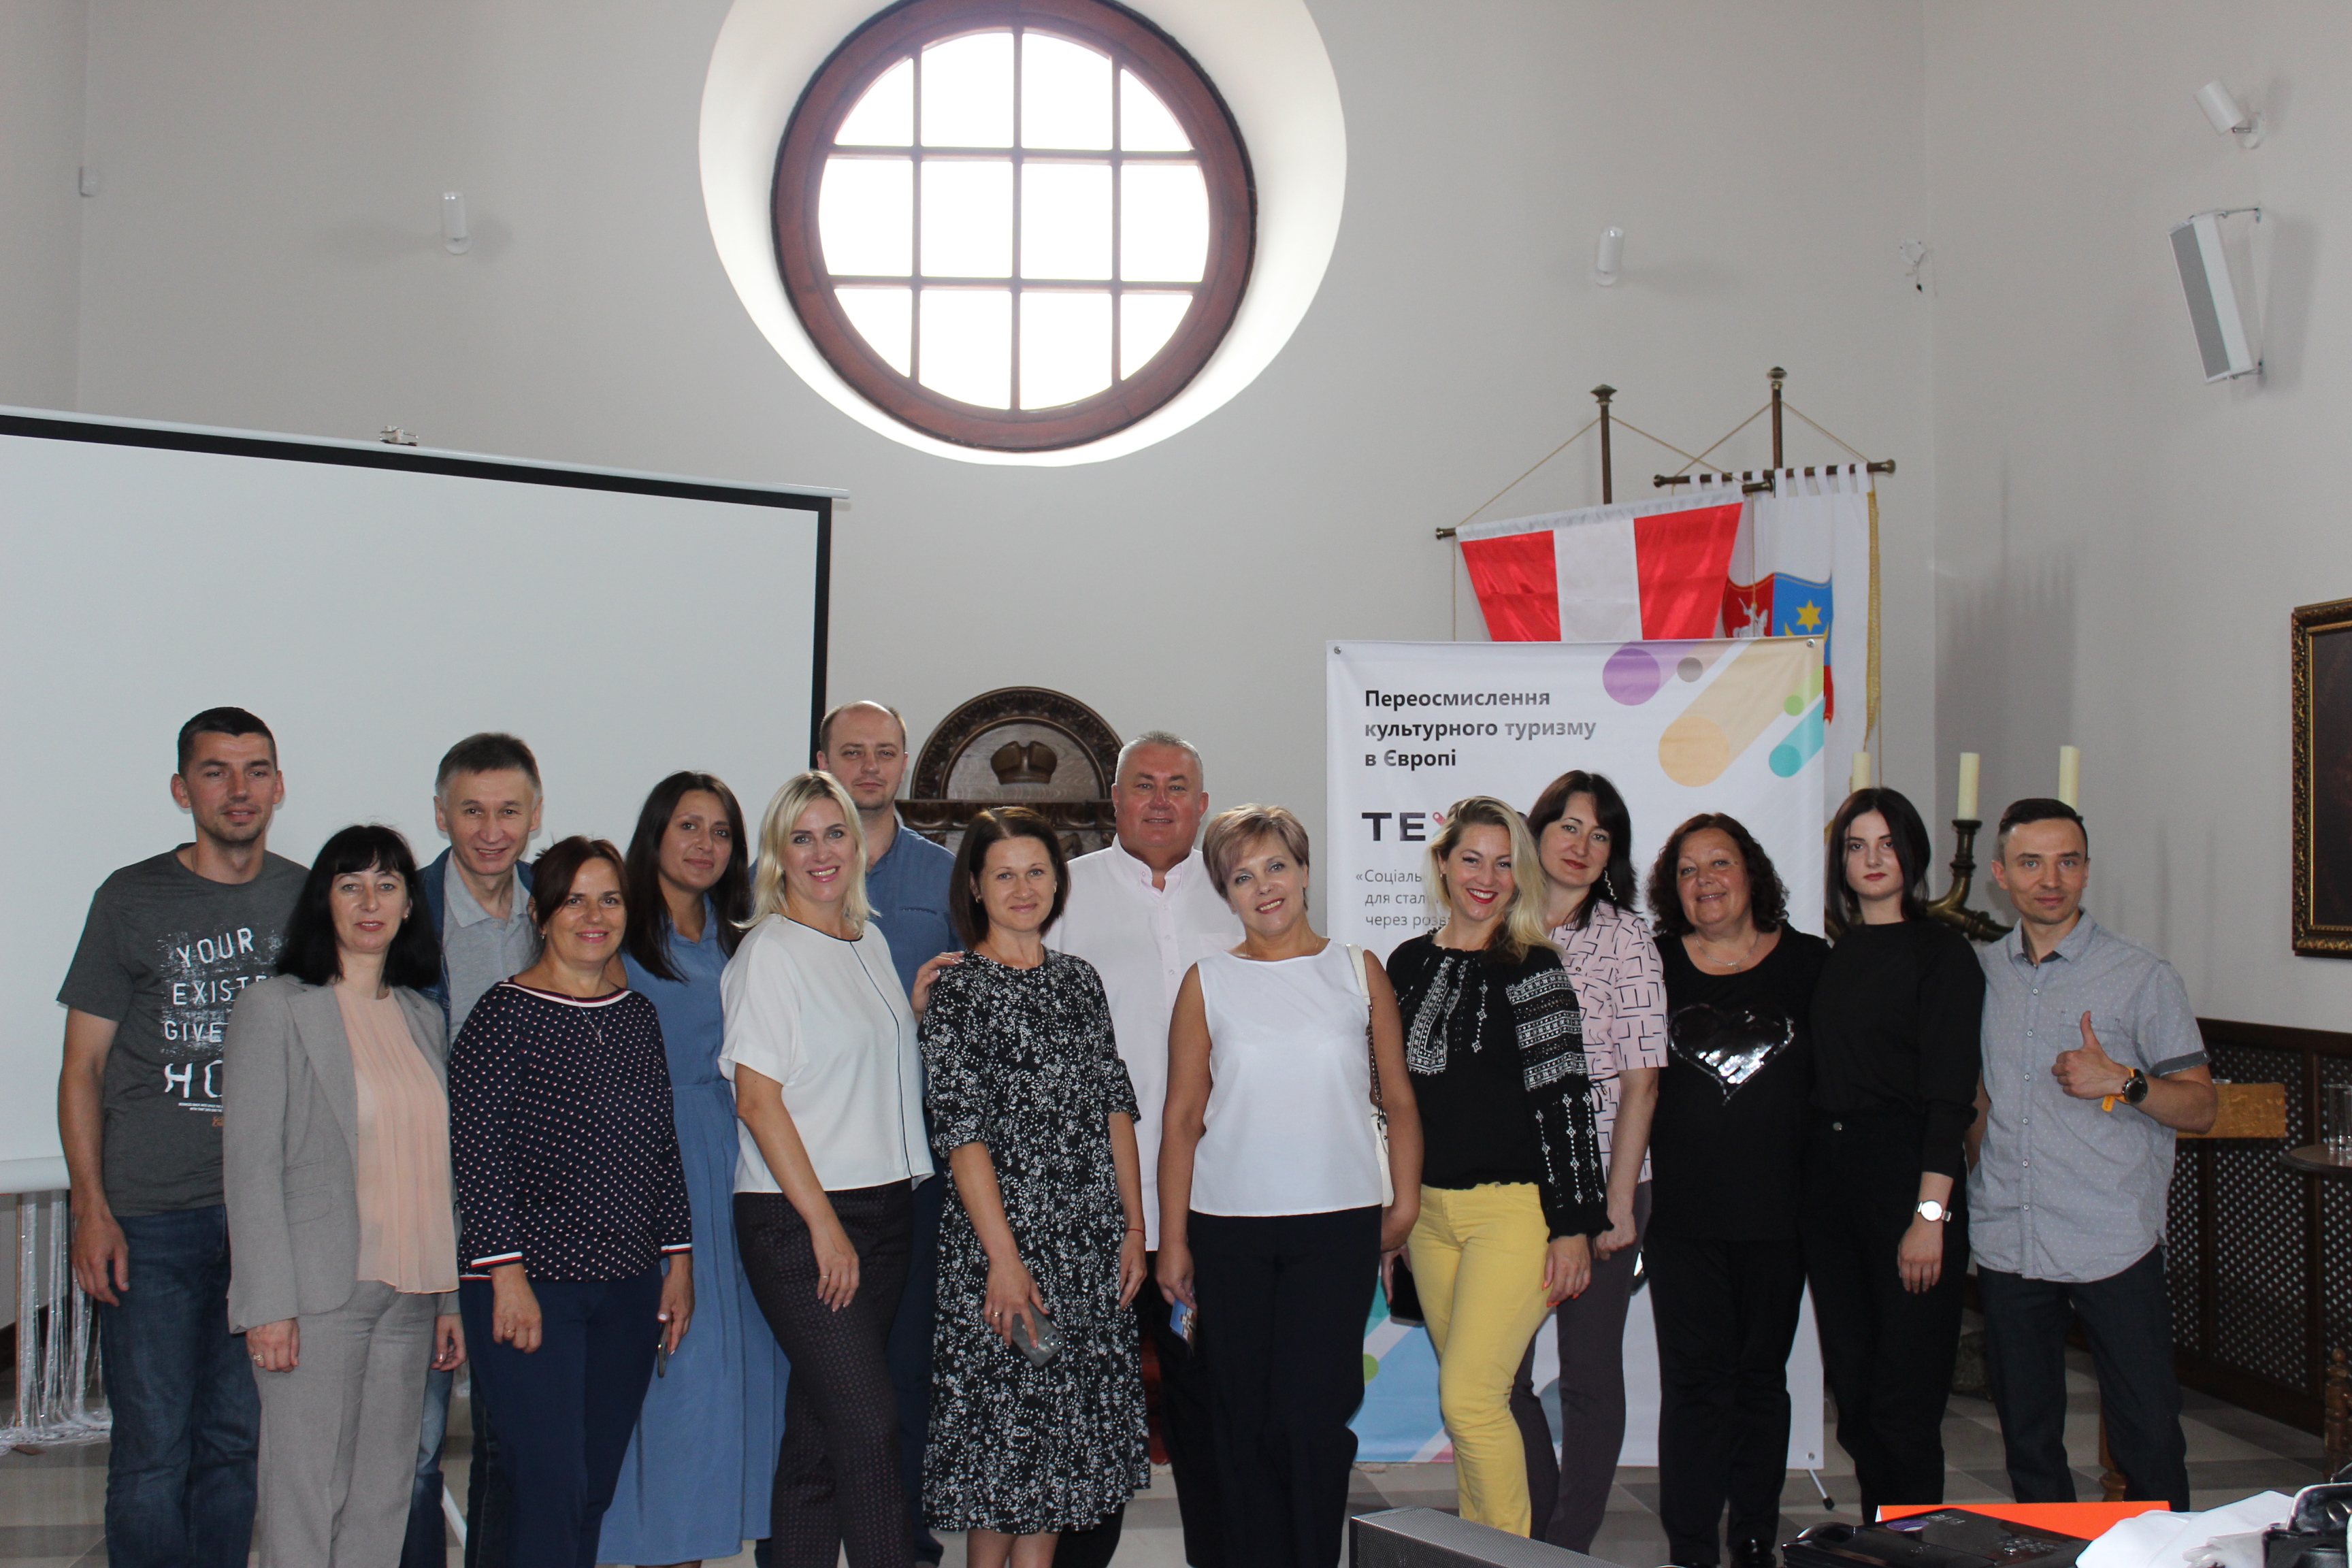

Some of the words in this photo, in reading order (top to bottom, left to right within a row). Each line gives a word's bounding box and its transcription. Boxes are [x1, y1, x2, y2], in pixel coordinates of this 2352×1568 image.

[1365, 689, 1550, 712] Переосмислення
[1365, 722, 1498, 742] культурного
[1504, 721, 1597, 740] туризму
[1365, 754, 1377, 766] в
[1384, 749, 1456, 771] Європі
[1365, 894, 1390, 906] для
[1395, 894, 1439, 904] стал
[1365, 915, 1407, 930] через
[1413, 916, 1450, 930] розв
[176, 927, 254, 968] YOUR
[172, 975, 268, 1006] EXIST
